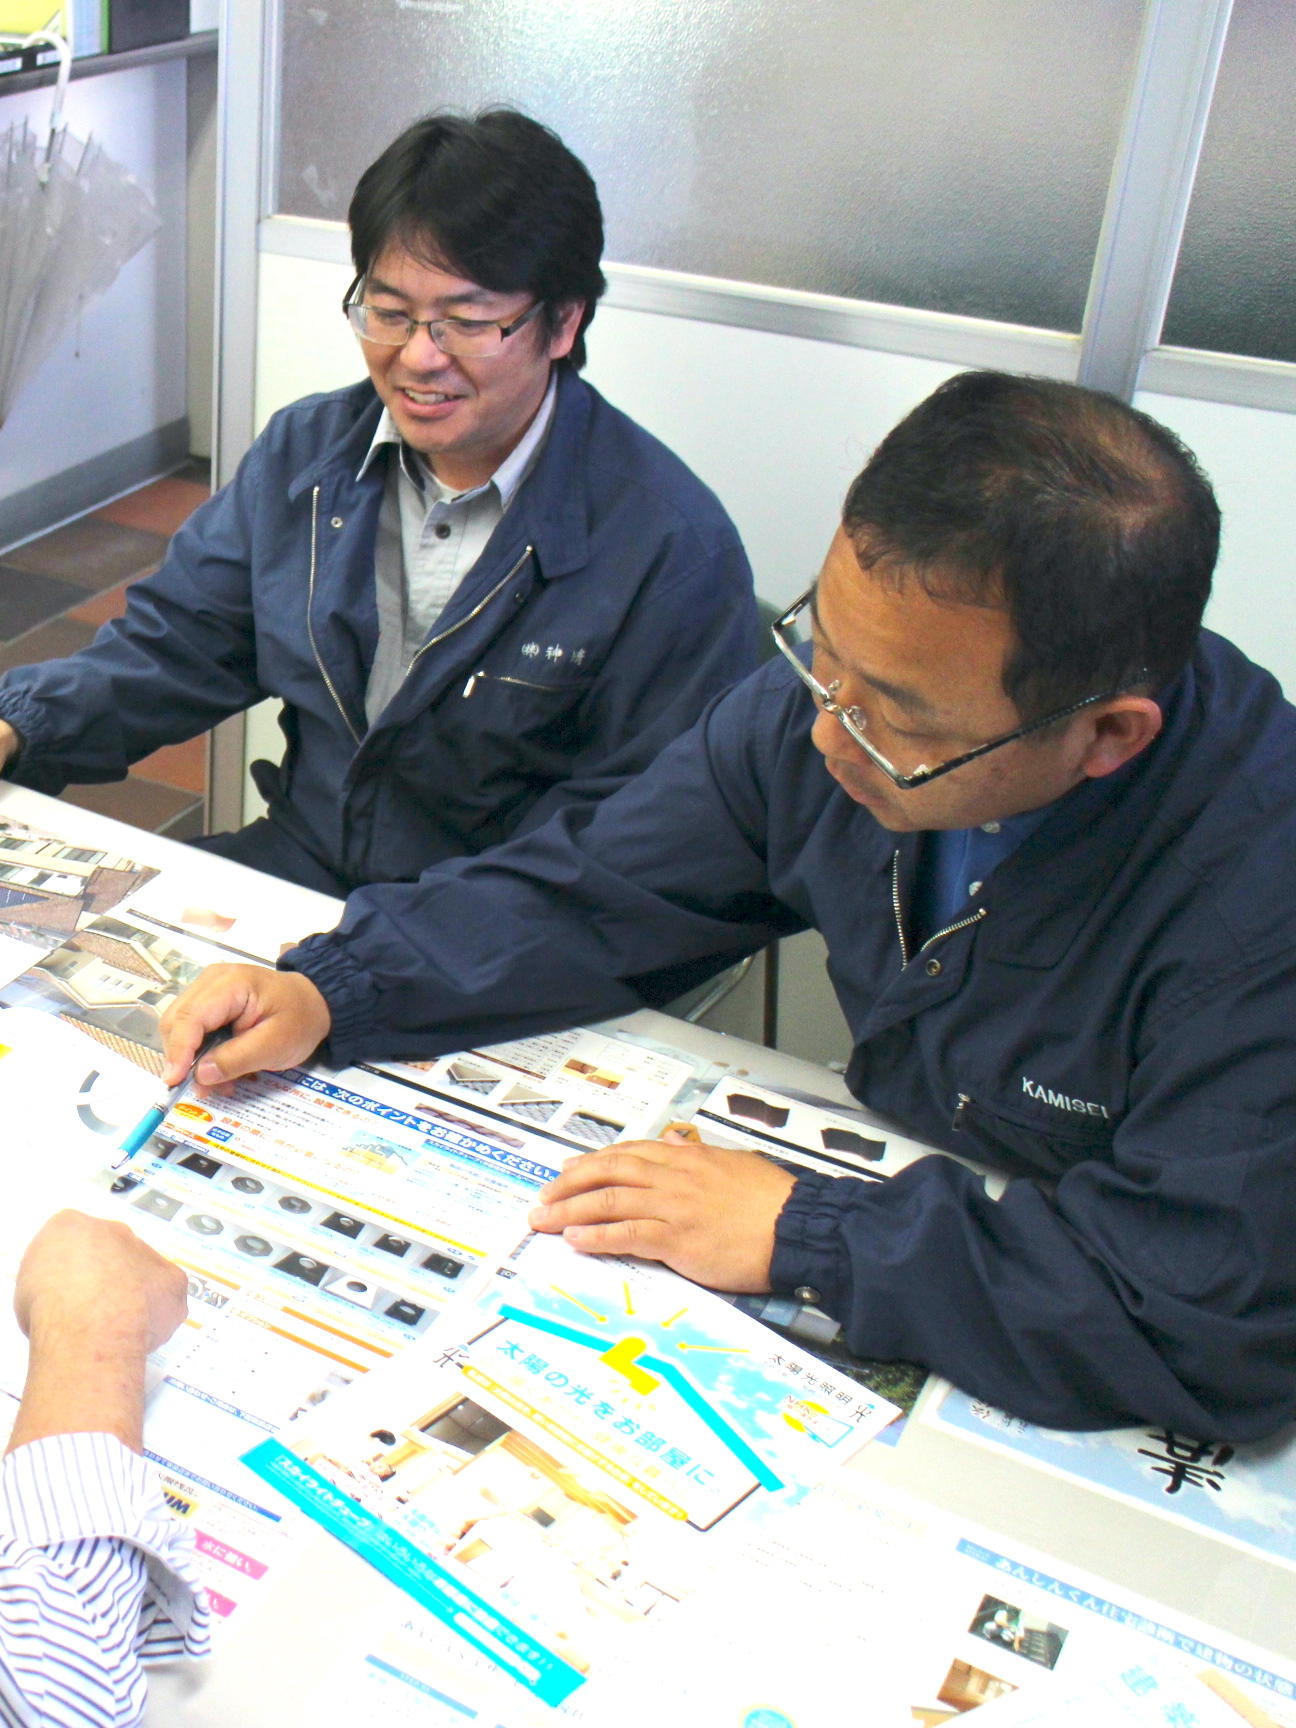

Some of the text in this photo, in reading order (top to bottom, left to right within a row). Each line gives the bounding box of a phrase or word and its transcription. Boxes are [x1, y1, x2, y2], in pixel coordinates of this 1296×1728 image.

[1022, 1076, 1109, 1119] KAMISEI
[768, 1353, 853, 1405] 太陽光照明
[495, 1339, 721, 1496] 太陽の光をお部屋に。
[848, 1404, 872, 1423] 光
[202, 1538, 253, 1573] 水に強い。
